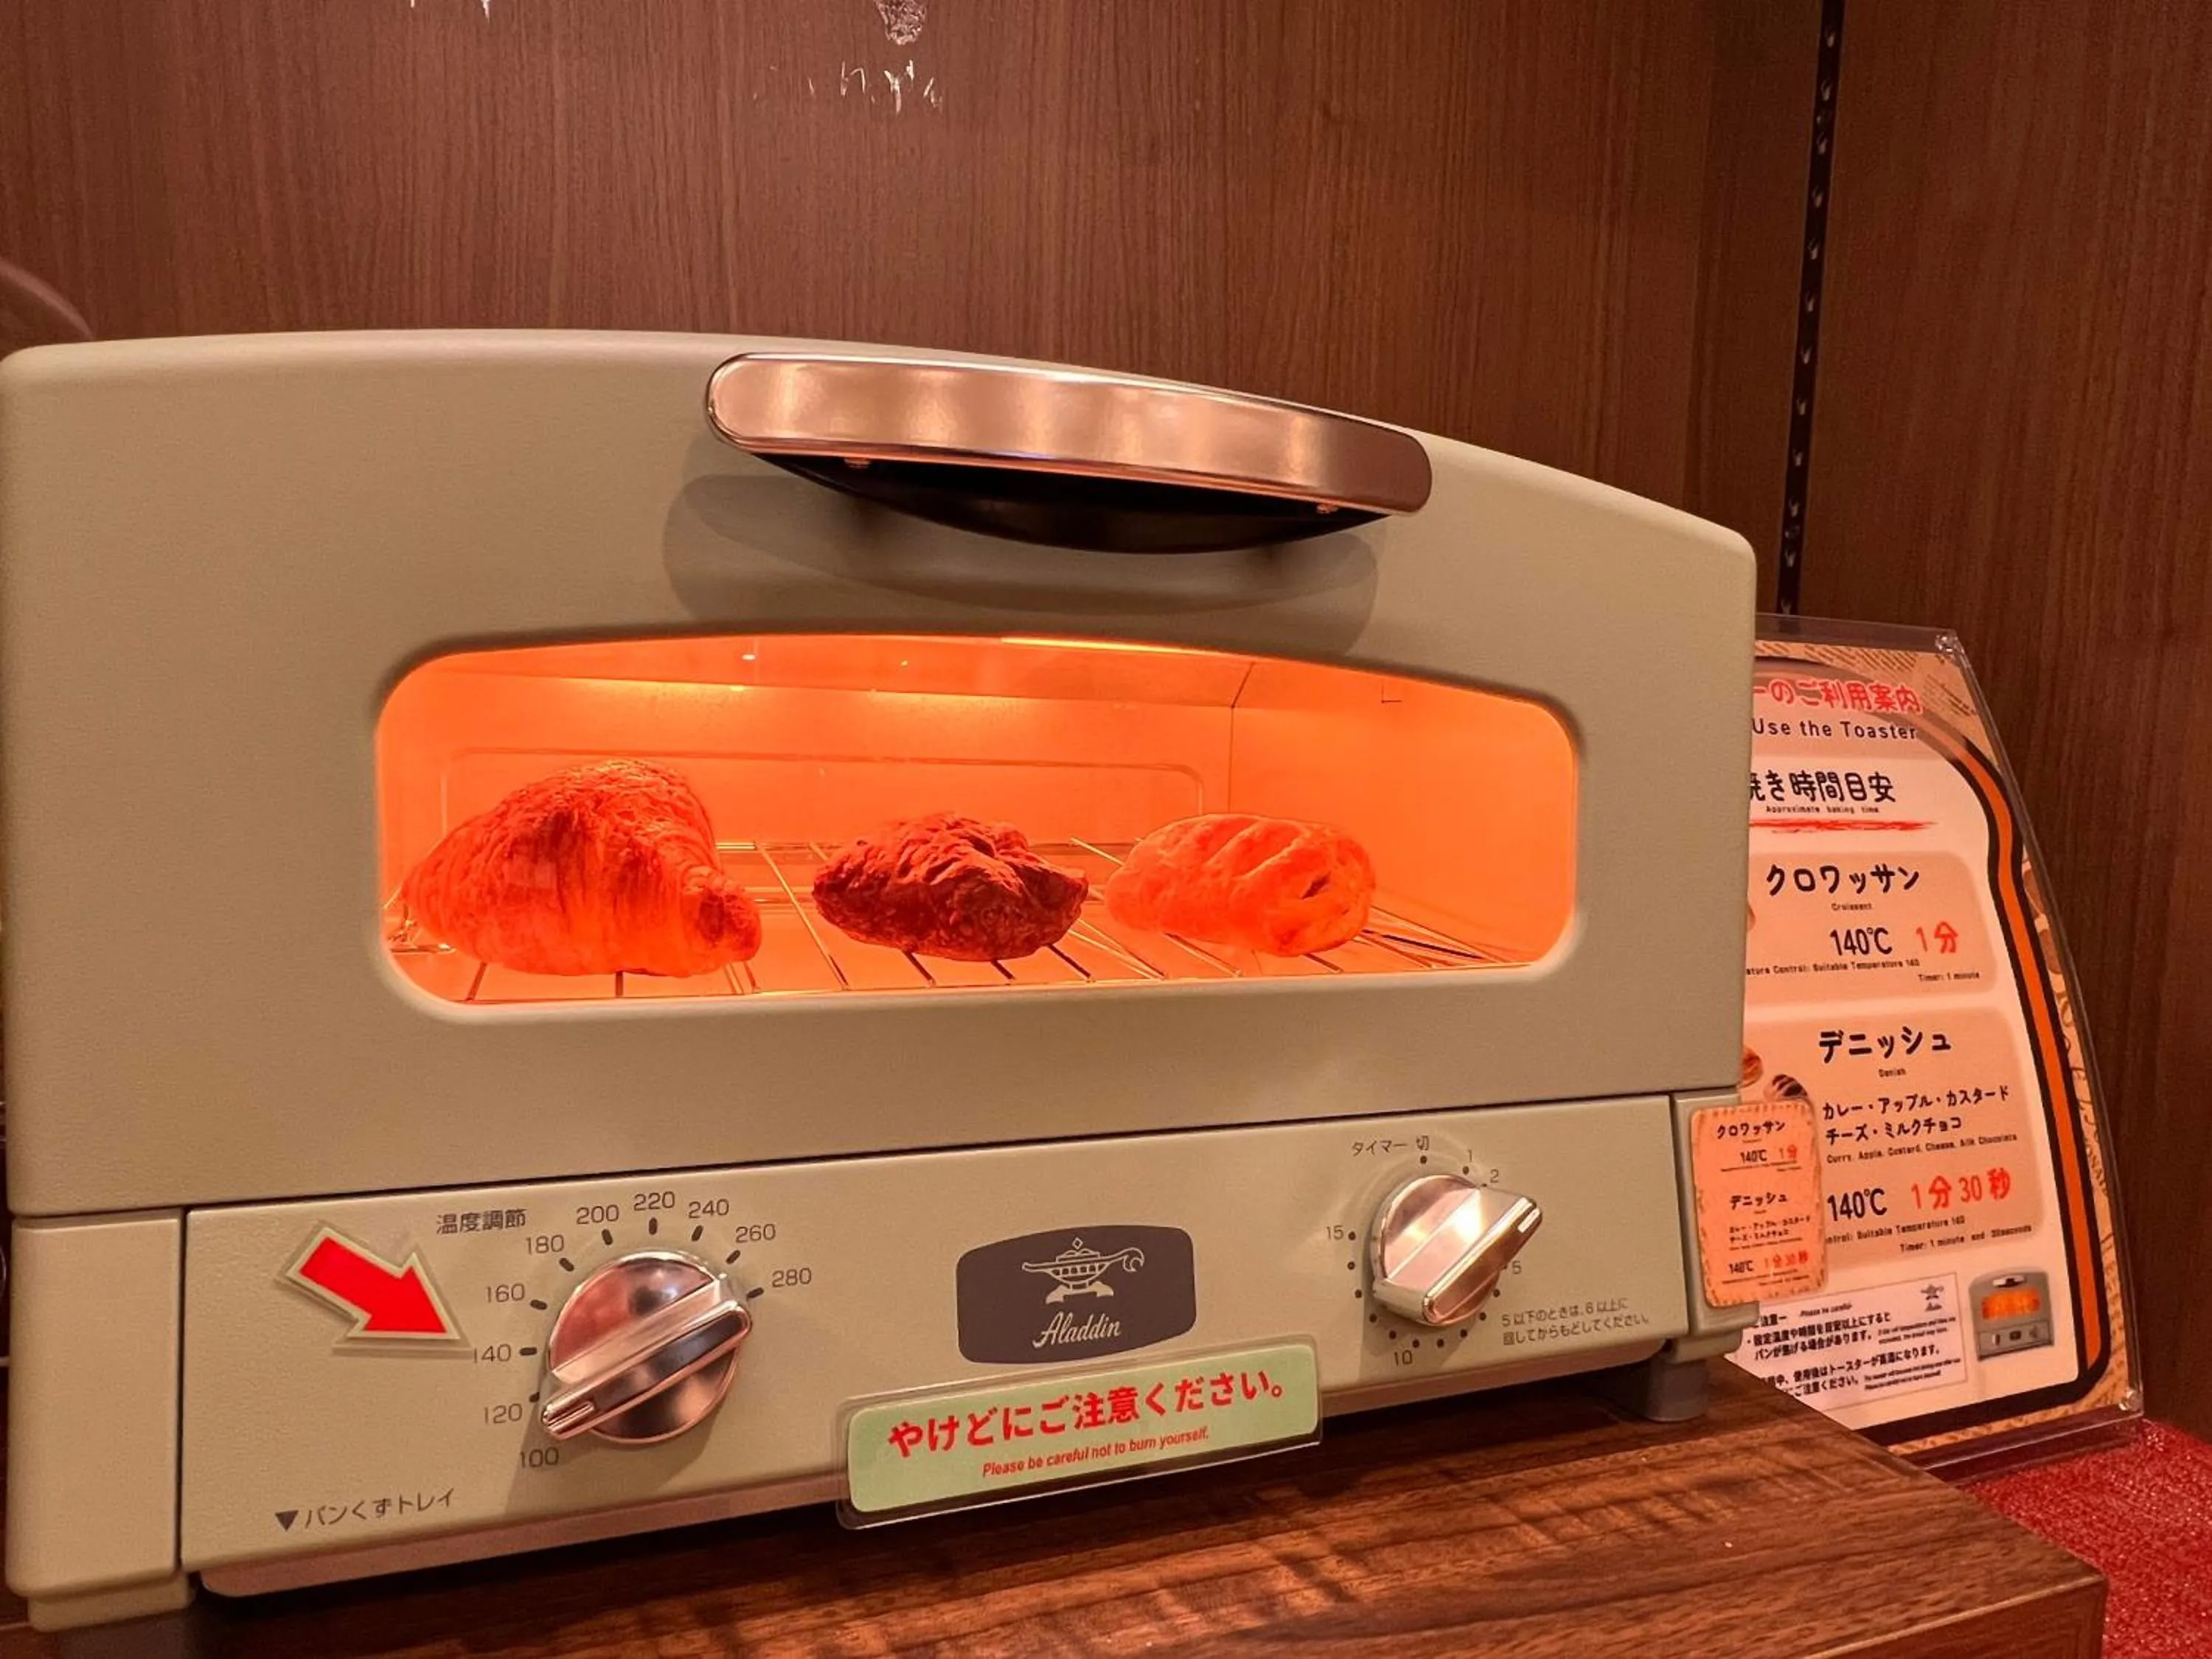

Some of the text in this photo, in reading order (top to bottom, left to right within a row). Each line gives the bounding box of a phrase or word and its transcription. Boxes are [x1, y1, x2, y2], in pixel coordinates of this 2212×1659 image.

[1752, 718, 1916, 739] Use the Toaster
[1767, 863, 1919, 897] クロワッサン
[1819, 1026, 1952, 1063] デニッシュ
[1823, 1085, 2009, 1120] カレー・アップル・カスタード
[1826, 1116, 1962, 1145] チーズ・ミルクチョコ
[1352, 1135, 1430, 1156] タイマー 切
[1467, 1150, 1473, 1162] 1
[1489, 1169, 1499, 1183] 2
[633, 1192, 675, 1212] 220
[688, 1199, 729, 1219] 240
[436, 1208, 526, 1235] 温度調節
[576, 1205, 619, 1225] 200
[735, 1222, 776, 1244] 260
[1326, 1225, 1344, 1239] 15
[525, 1234, 565, 1253] 180
[772, 1267, 812, 1289] 280
[1512, 1261, 1522, 1275] 5
[485, 1283, 526, 1303] 160
[1032, 1311, 1121, 1349] Aladdin
[473, 1343, 512, 1363] 140
[1394, 1350, 1413, 1366] 10
[483, 1404, 523, 1424] 120
[887, 1370, 1284, 1458] やけどにご注意ください。
[519, 1446, 559, 1469] 100
[982, 1425, 1209, 1478] Please be careful not to burn yourself.
[305, 1489, 455, 1528] パンくずトレイ
